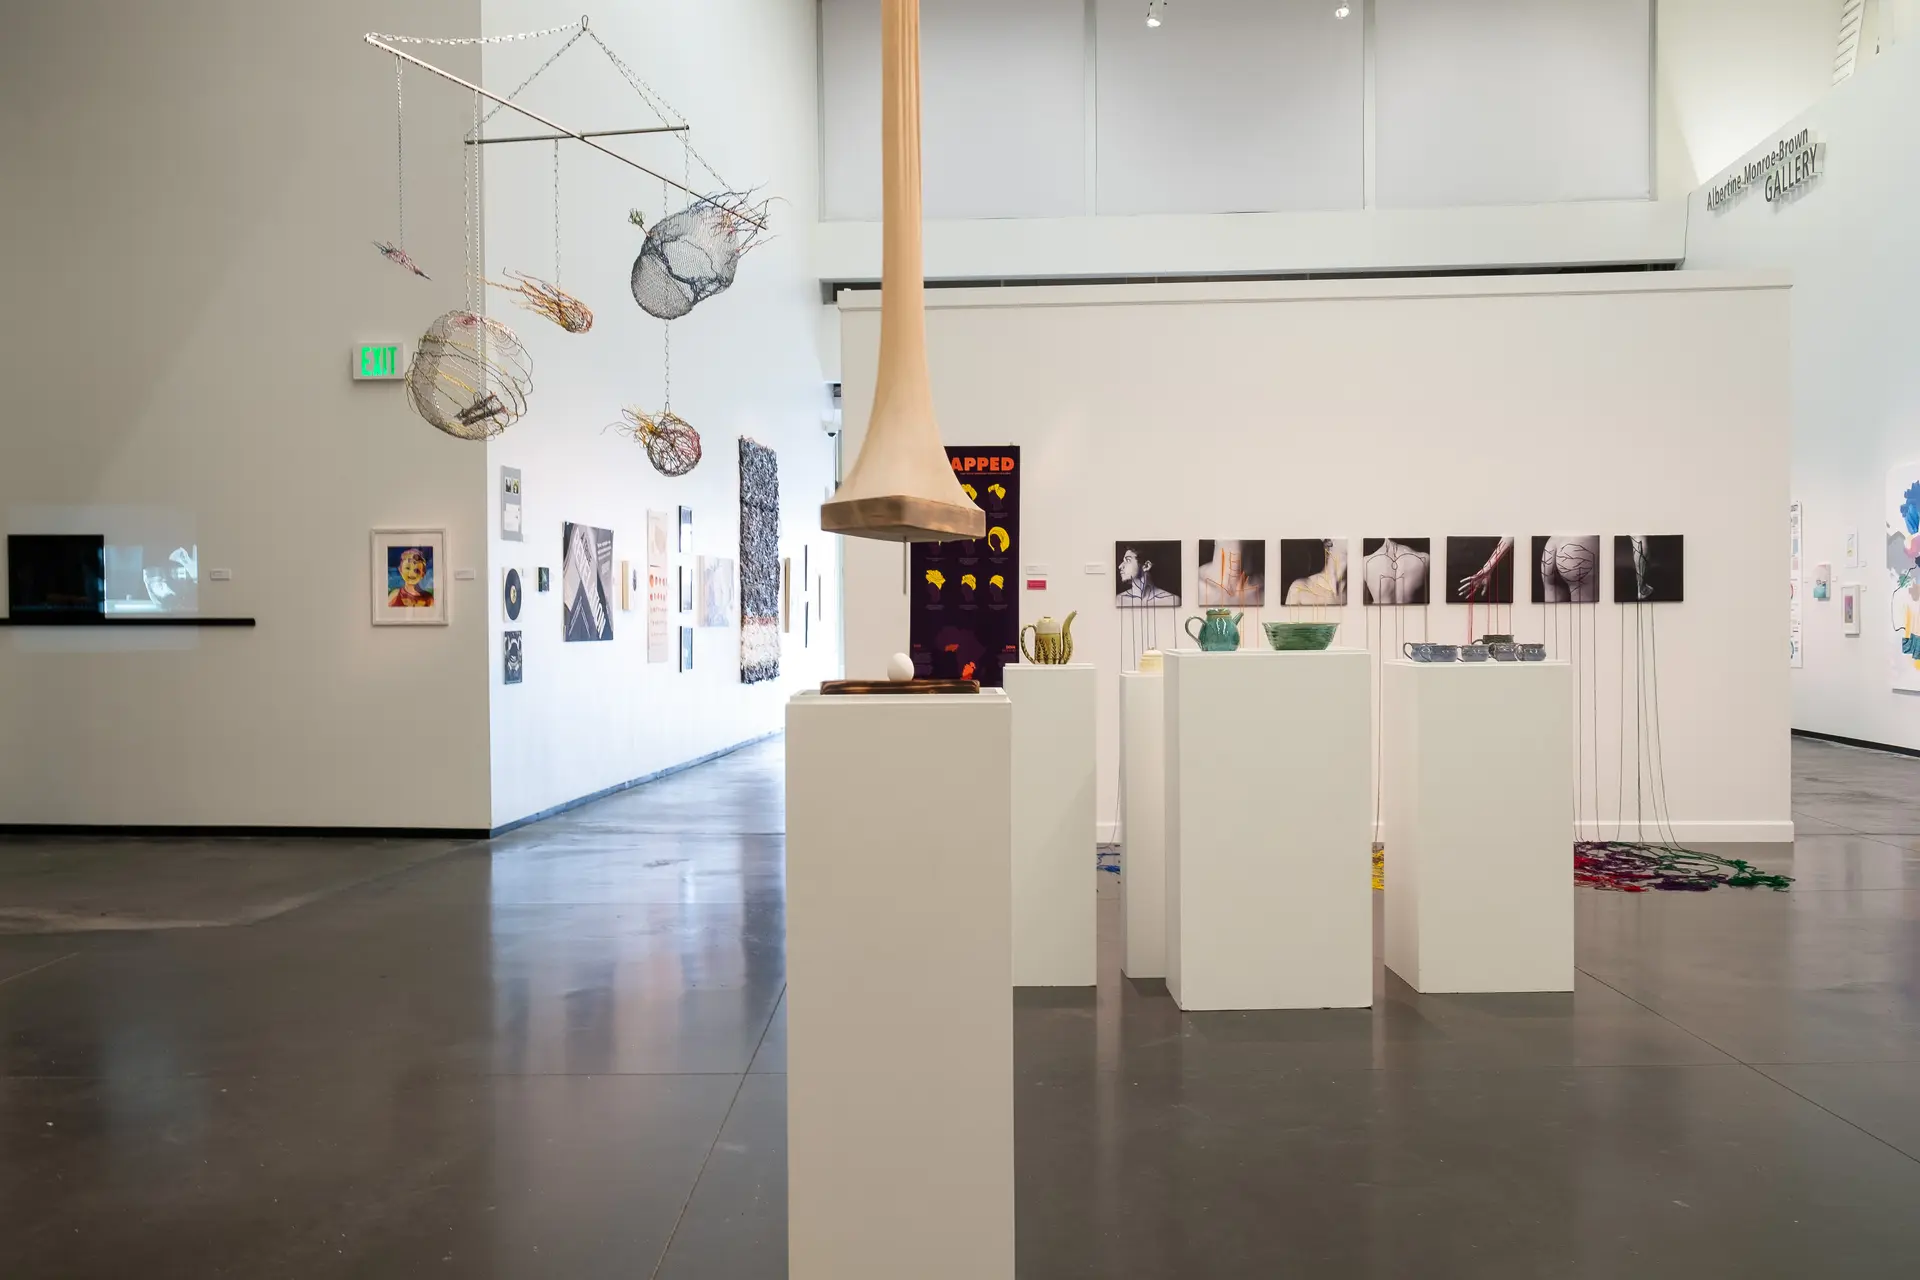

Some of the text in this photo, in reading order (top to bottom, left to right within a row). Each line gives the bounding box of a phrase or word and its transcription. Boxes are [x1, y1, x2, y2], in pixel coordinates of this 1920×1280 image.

[1707, 128, 1808, 211] Albertine Monroe-Brown
[1765, 143, 1818, 202] GALLERY
[361, 346, 398, 376] EXIT
[952, 456, 1015, 471] APPED
